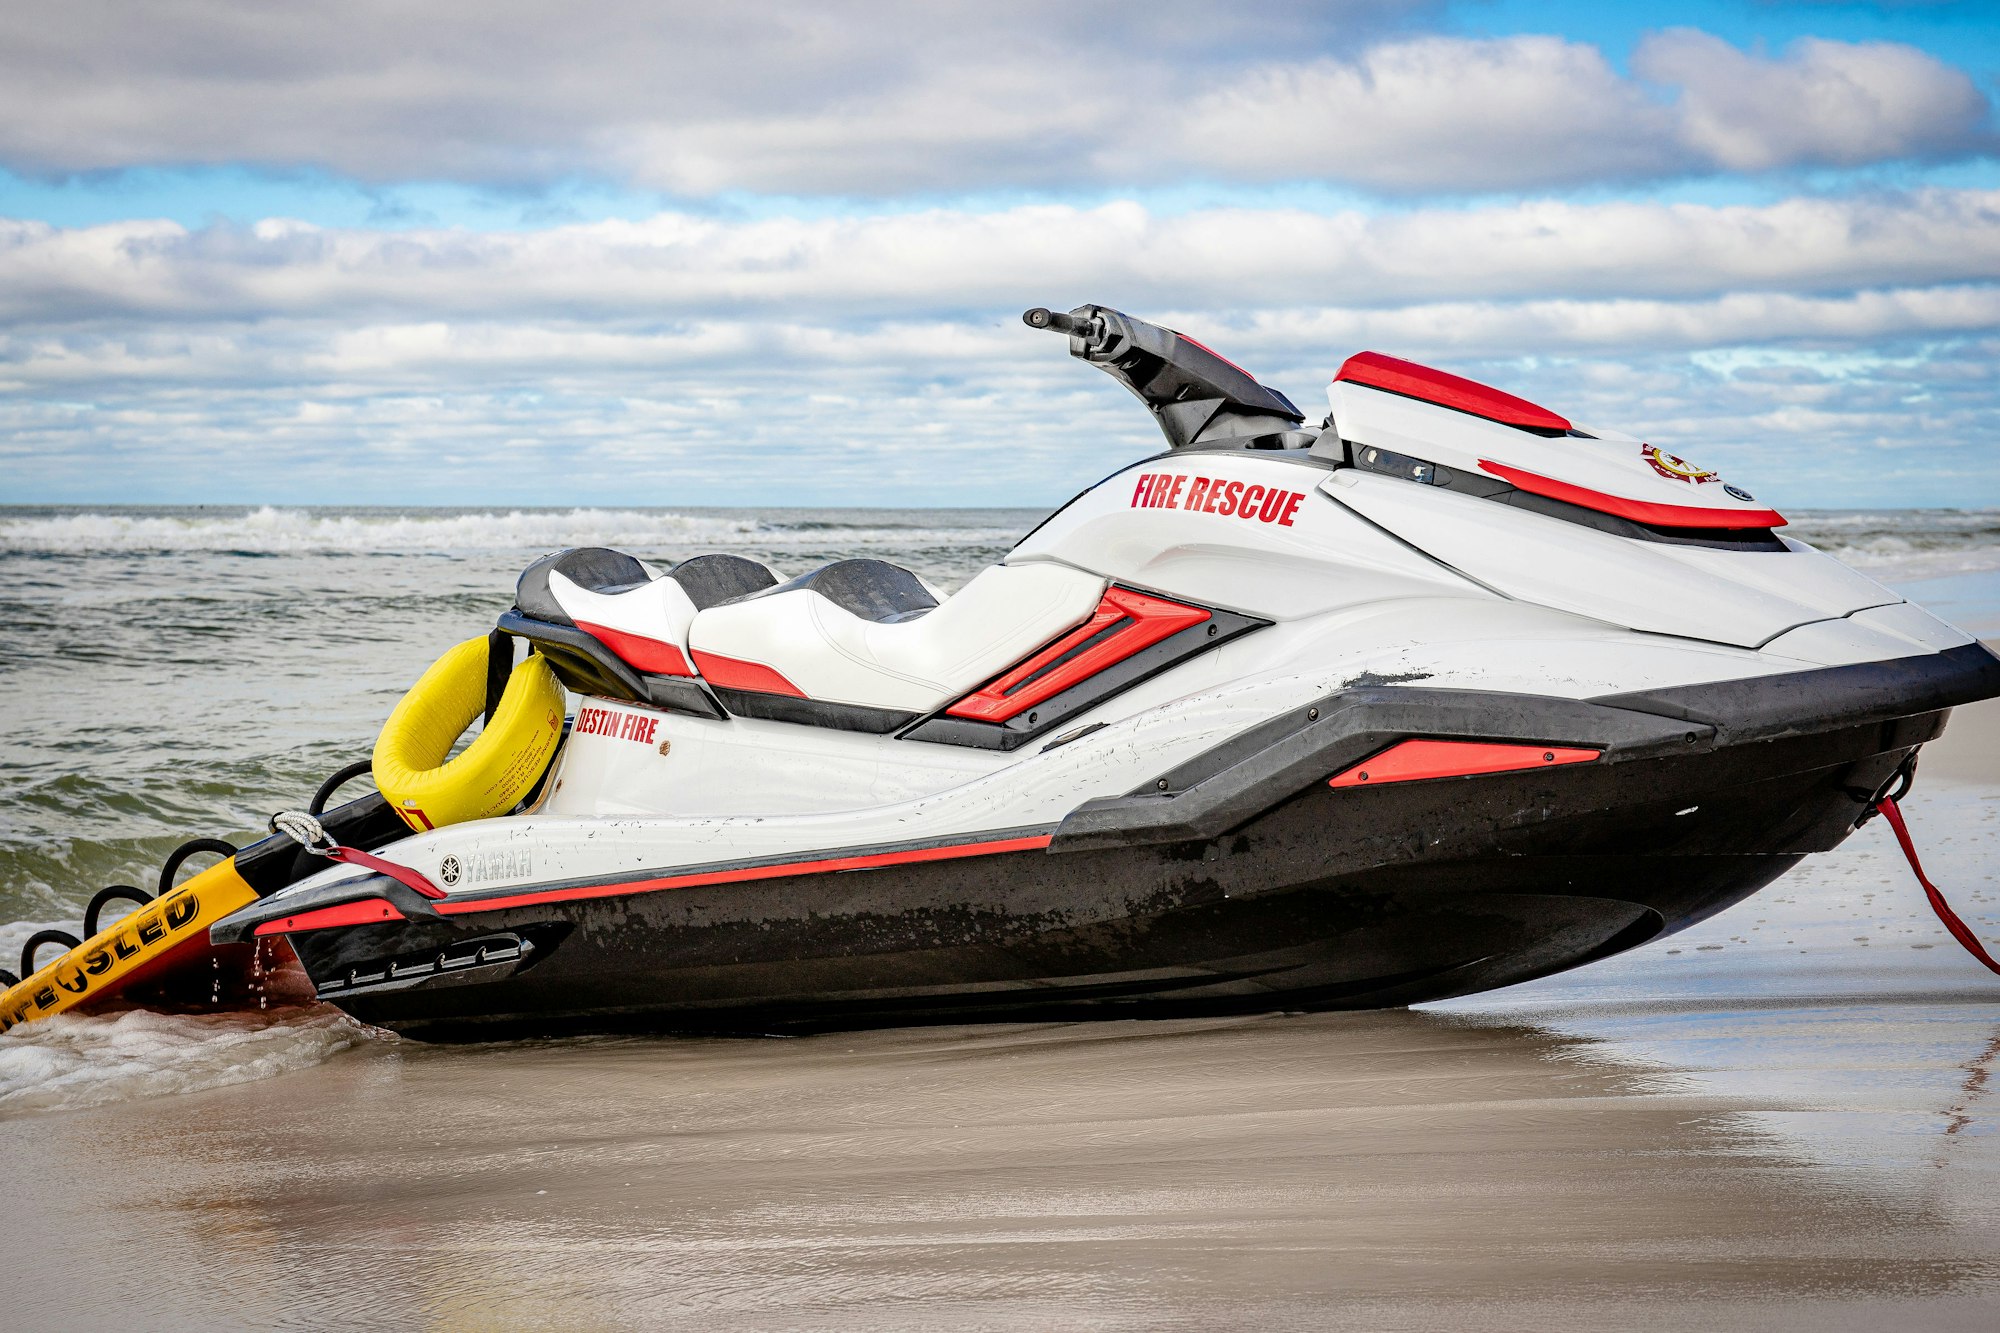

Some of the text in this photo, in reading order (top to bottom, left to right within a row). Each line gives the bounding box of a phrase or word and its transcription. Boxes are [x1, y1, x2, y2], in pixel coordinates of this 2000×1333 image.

[1131, 474, 1306, 527] FIRE RESCUE
[576, 708, 659, 744] DESTIN FIRE
[541, 732, 554, 757] MARINE
[521, 758, 541, 785] RESCUE
[480, 785, 520, 818] PRODUCTS
[82, 888, 200, 976] SLED
